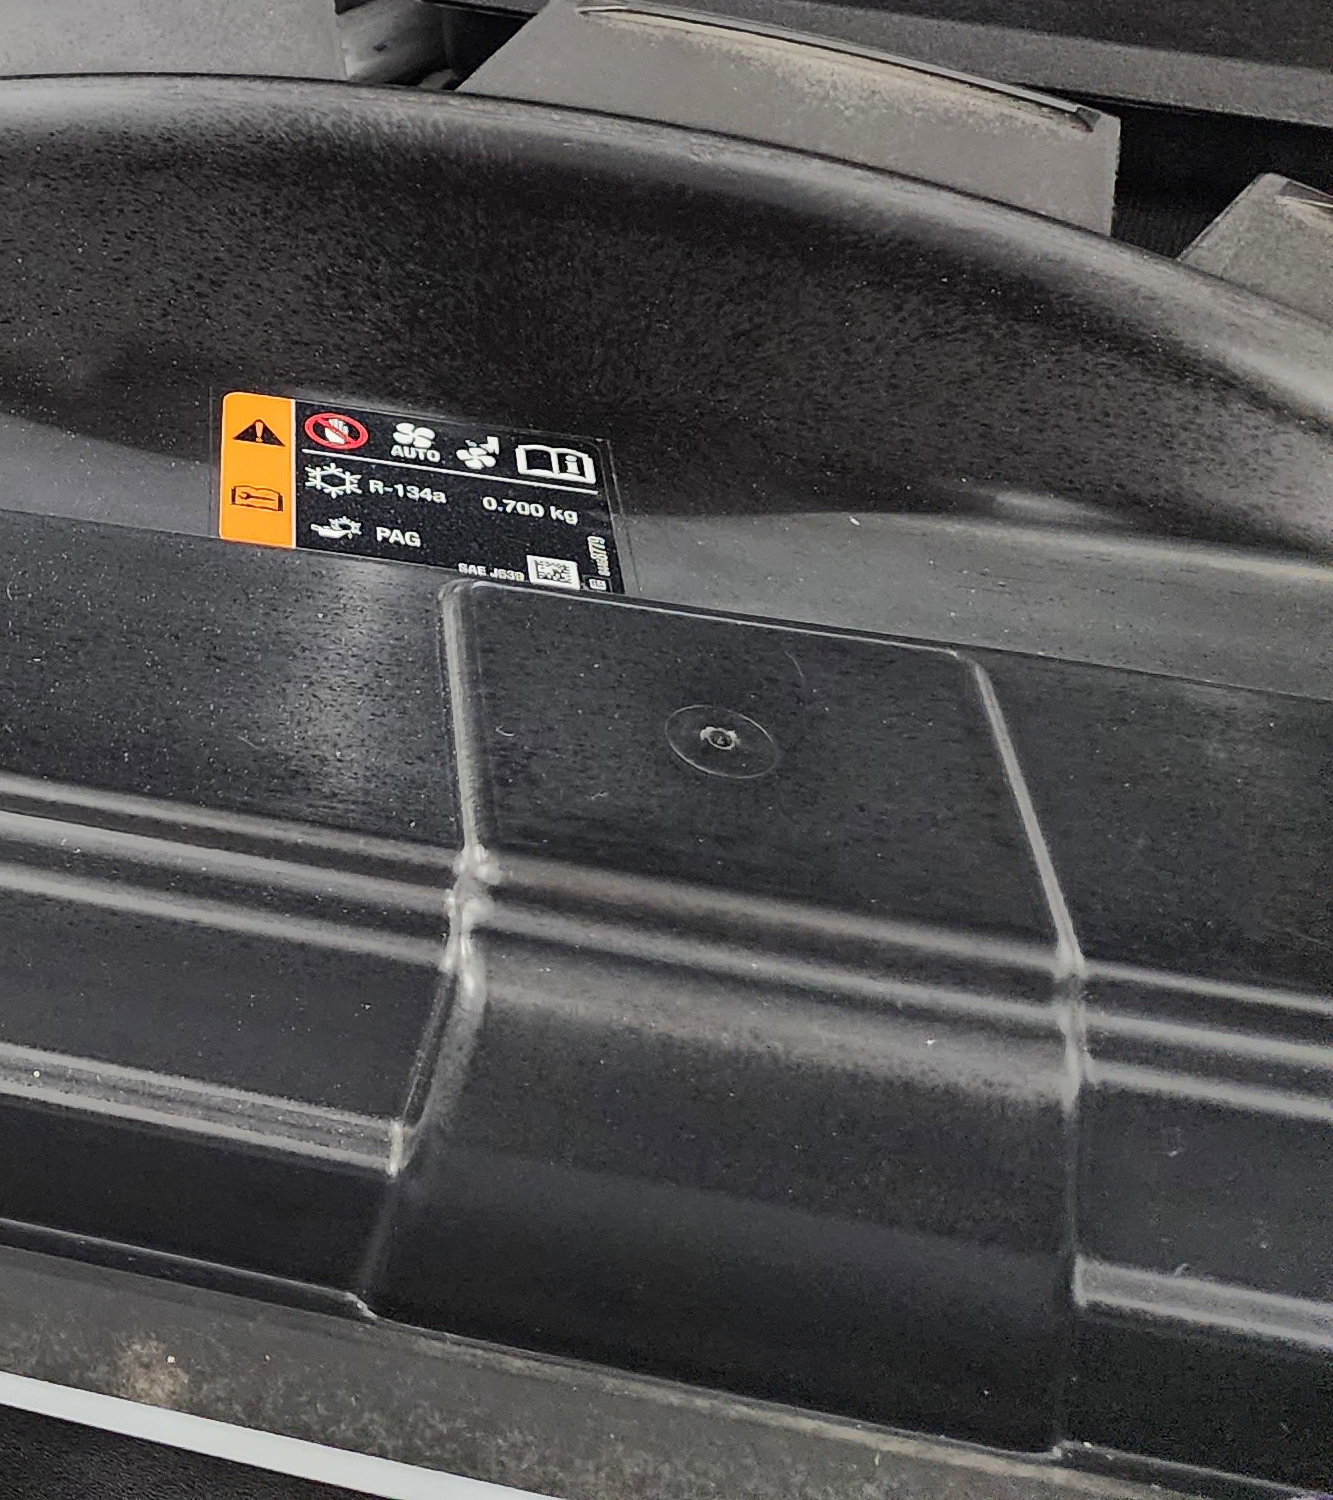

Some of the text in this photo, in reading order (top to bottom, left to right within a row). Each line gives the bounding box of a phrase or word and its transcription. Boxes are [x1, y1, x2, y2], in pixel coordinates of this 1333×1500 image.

[390, 444, 441, 463] AUTO
[368, 479, 579, 525] R-134a 0.700 kg
[375, 526, 422, 548] PAG
[457, 562, 488, 578] SAE
